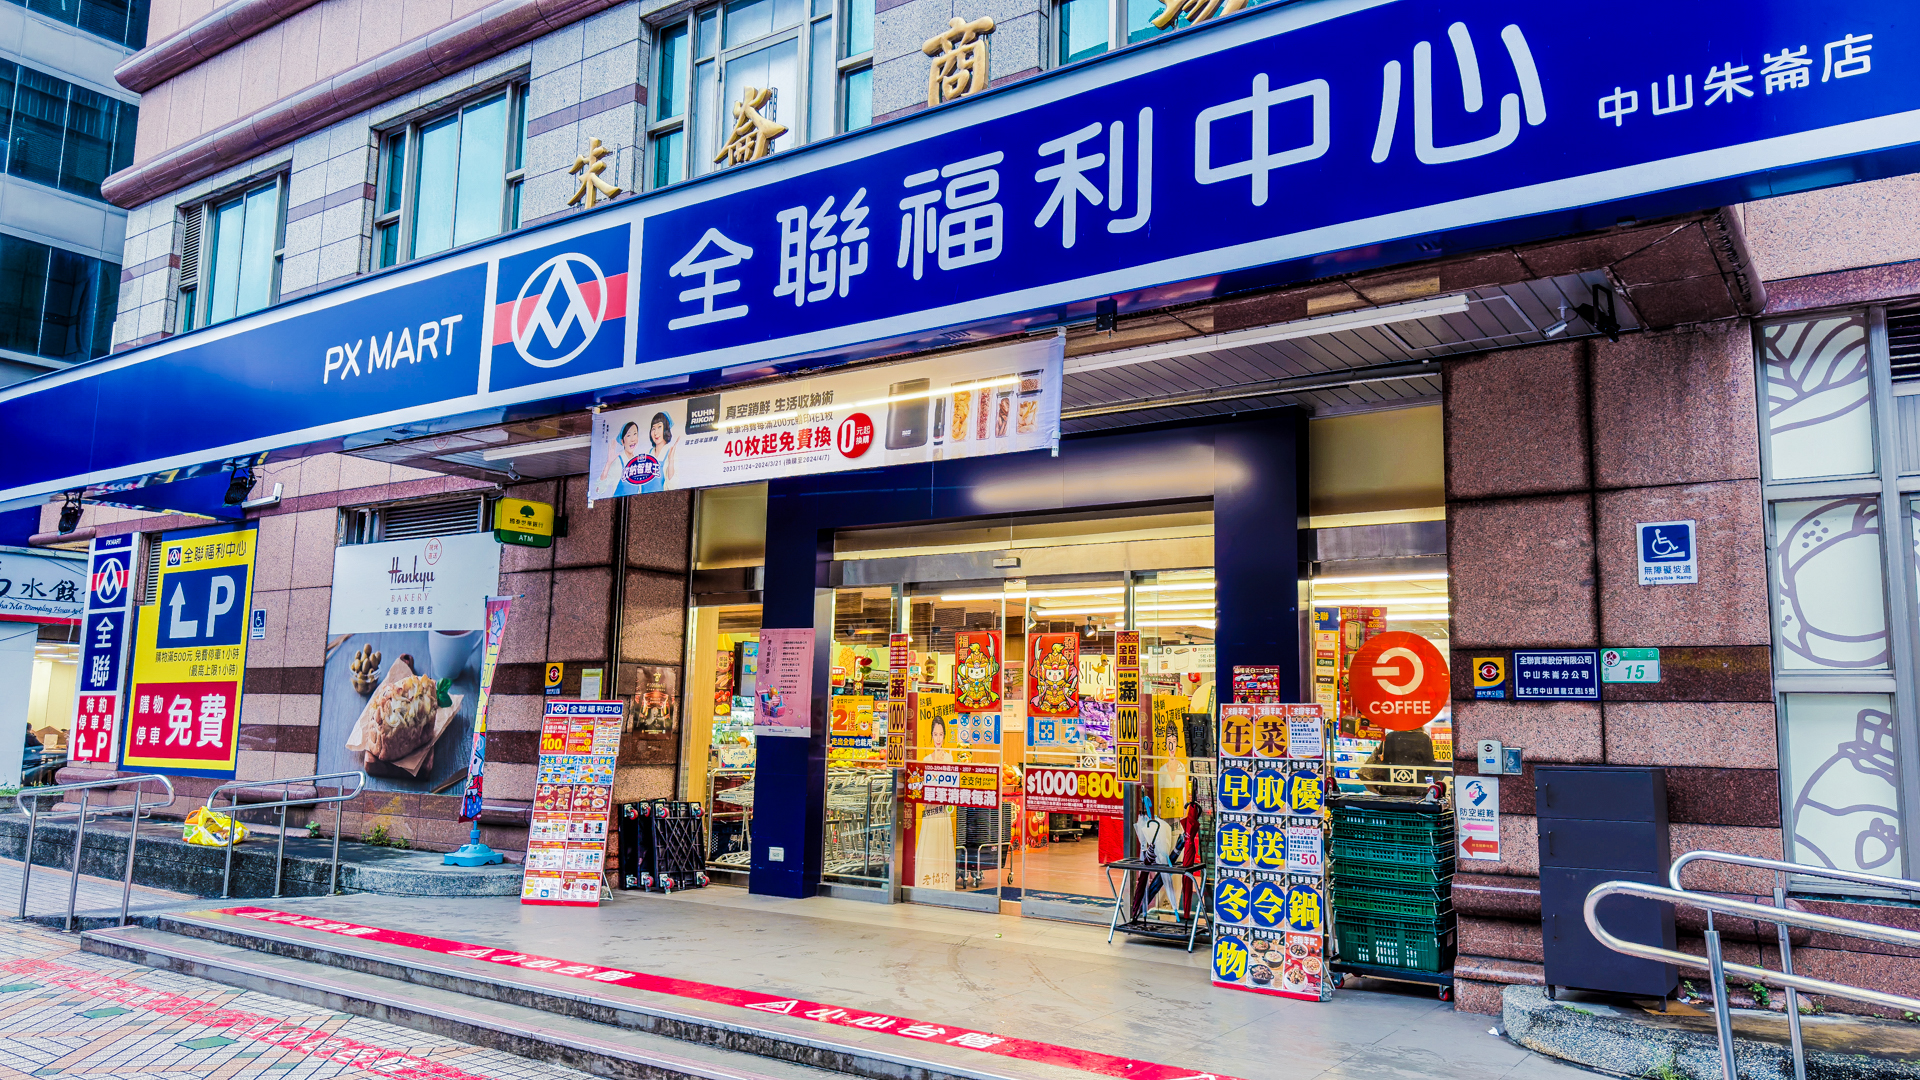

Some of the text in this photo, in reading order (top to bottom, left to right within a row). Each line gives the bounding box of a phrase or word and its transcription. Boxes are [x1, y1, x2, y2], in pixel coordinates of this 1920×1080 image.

[1598, 33, 1873, 127] 中山朱崙店
[668, 22, 1548, 331] 全聯福利中心
[323, 314, 463, 384] PX MART
[691, 408, 715, 418] KUHN
[725, 390, 834, 420] 真空鎖鮮 生活收納術
[690, 415, 715, 425] RIKON
[724, 426, 831, 457] 40枚起免費換
[518, 534, 534, 543] ATM
[183, 540, 247, 564] 全聯福利中心
[388, 555, 436, 592] Hankyu
[1644, 565, 1692, 575] 無障礙坡道
[205, 575, 236, 638] P
[391, 593, 430, 602] BAKERY
[90, 616, 114, 687] 全聯
[195, 648, 239, 662] 免費停車1小時
[1519, 655, 1592, 665] 全聯實業股份有限公司
[189, 664, 238, 677] (最高上限1小時)
[1523, 670, 1590, 680] 中山朱崙分公司
[1625, 664, 1646, 680] 15
[1118, 681, 1137, 702] 滿
[86, 697, 107, 713] 特約
[139, 695, 164, 714] 購物
[569, 705, 621, 713] 全聯福利中心
[1369, 700, 1431, 715] COFFEE
[78, 714, 112, 731] 停車場
[165, 693, 227, 748] 免費
[832, 709, 848, 731] 2
[95, 732, 108, 758] P
[136, 726, 161, 746] 停車
[542, 738, 563, 750] 100
[888, 743, 904, 761] 800
[925, 774, 958, 786] pxpay
[1027, 770, 1078, 796] $1,000
[923, 786, 997, 806] 單筆消費每滿
[1459, 807, 1495, 818] 防空避難
[1301, 853, 1317, 865] 50
[491, 954, 636, 982] 小心台階
[1216, 940, 1247, 979] 物
[804, 1007, 1005, 1049] 小心台階
